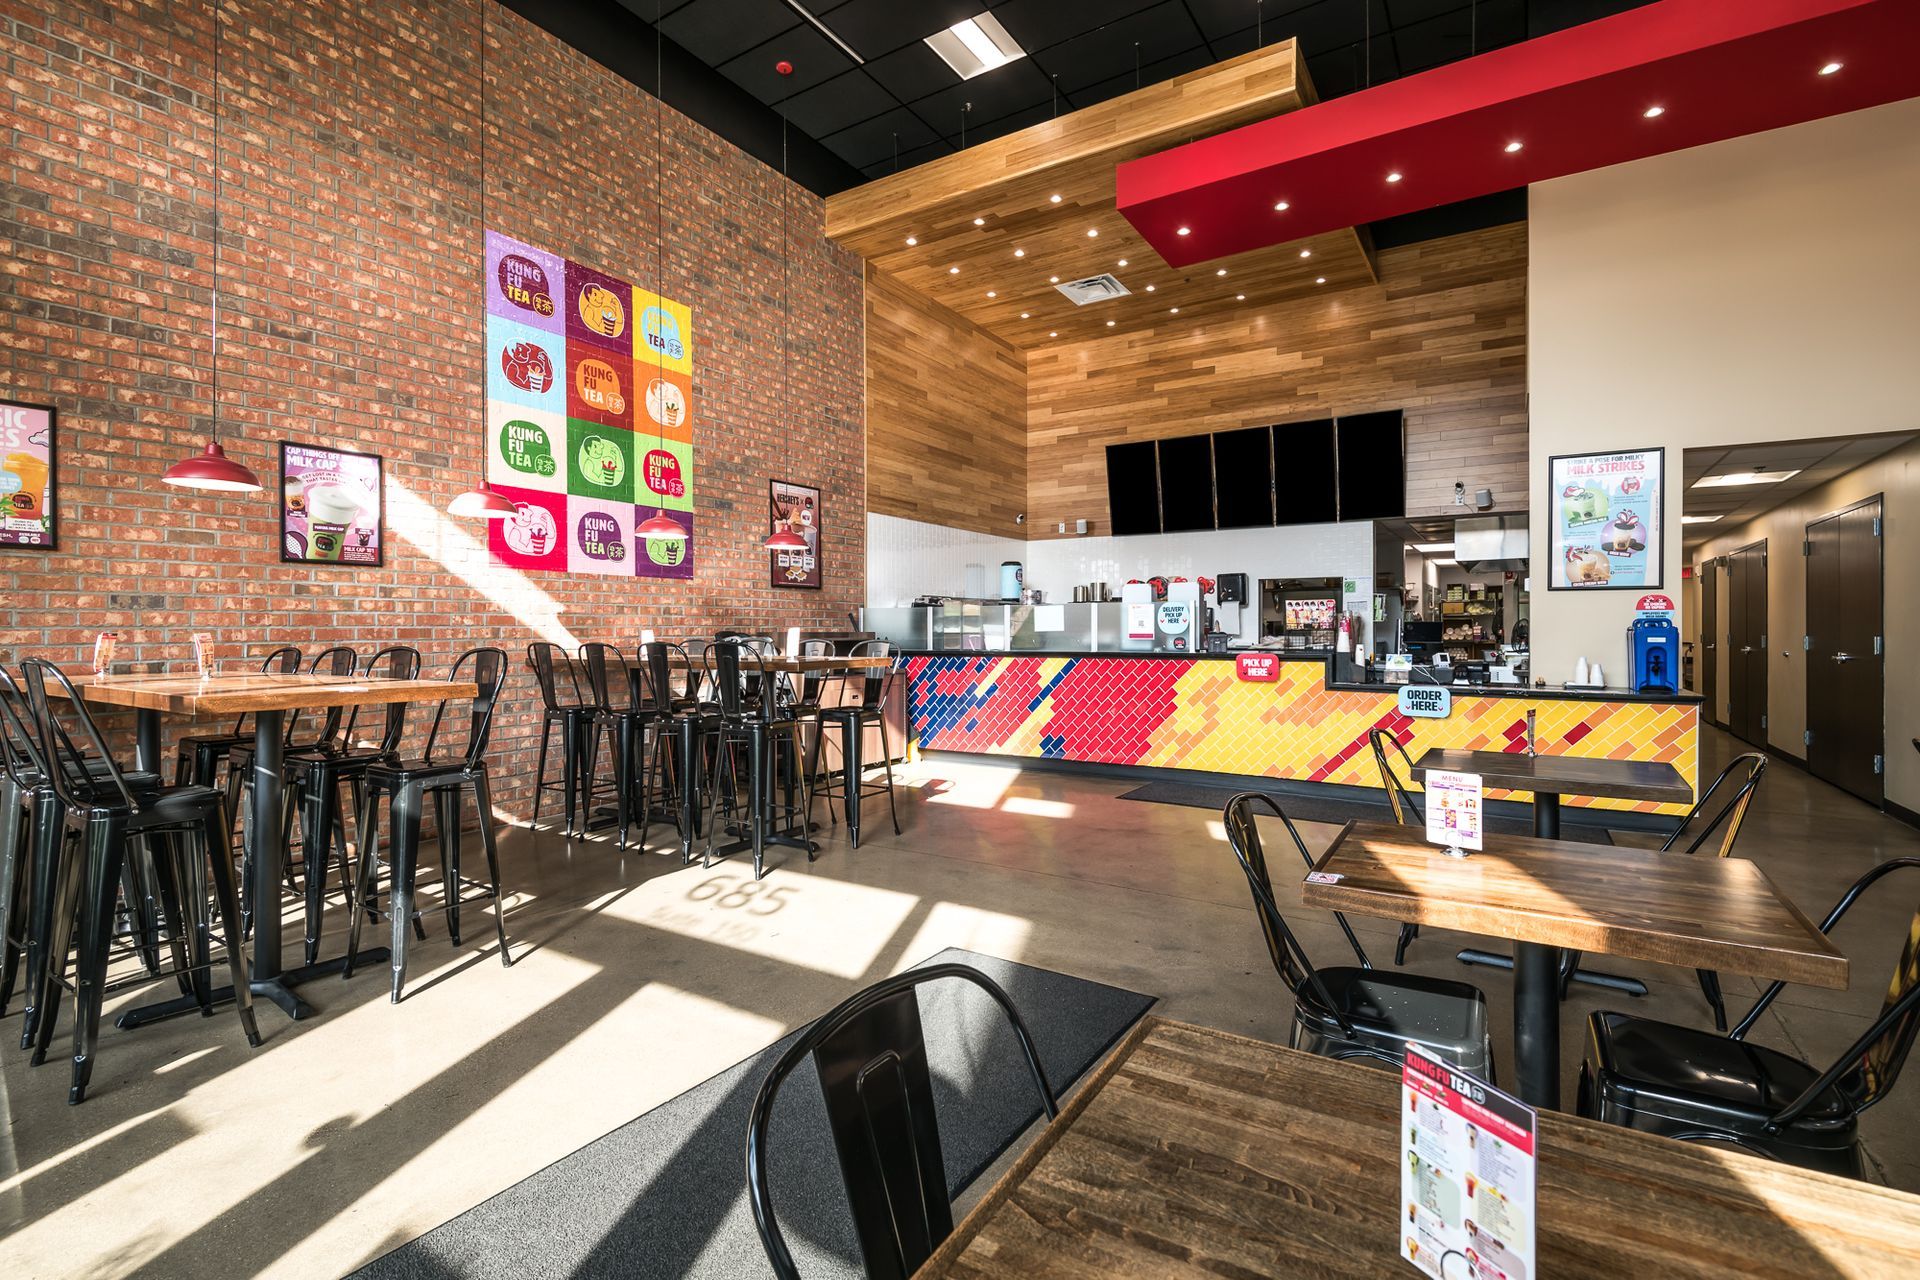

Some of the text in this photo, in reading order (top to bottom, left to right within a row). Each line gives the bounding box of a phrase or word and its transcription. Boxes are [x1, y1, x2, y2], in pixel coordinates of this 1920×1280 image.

[507, 258, 541, 282] KUNG
[507, 272, 522, 288] FU
[507, 284, 530, 304] TEA
[648, 333, 666, 349] TEA
[584, 364, 612, 383] KUNG
[584, 376, 596, 389] FU
[584, 387, 604, 404] TEA
[508, 424, 543, 444] KUNG
[287, 446, 300, 455] CAP
[302, 448, 326, 458] THINGS
[509, 438, 524, 453] FU
[287, 455, 313, 468] MILK
[316, 459, 337, 470] CAP
[508, 451, 532, 467] TEA
[649, 453, 675, 470] KUNG
[649, 466, 661, 478] FU
[1567, 461, 1645, 475] MILK STRIKES
[650, 476, 667, 490] TEA
[585, 517, 614, 532] KUNG
[585, 530, 598, 542] FU
[585, 541, 605, 555] TEA
[1243, 658, 1272, 667] PICK UP
[1248, 668, 1268, 677] HERE
[1407, 690, 1442, 701] ORDER
[1411, 701, 1438, 711] HERE
[1441, 775, 1463, 783] MENU
[686, 875, 802, 916] 685
[1407, 1052, 1436, 1077] KUNG
[1436, 1067, 1450, 1086] FU
[1450, 1074, 1472, 1099] TEA
